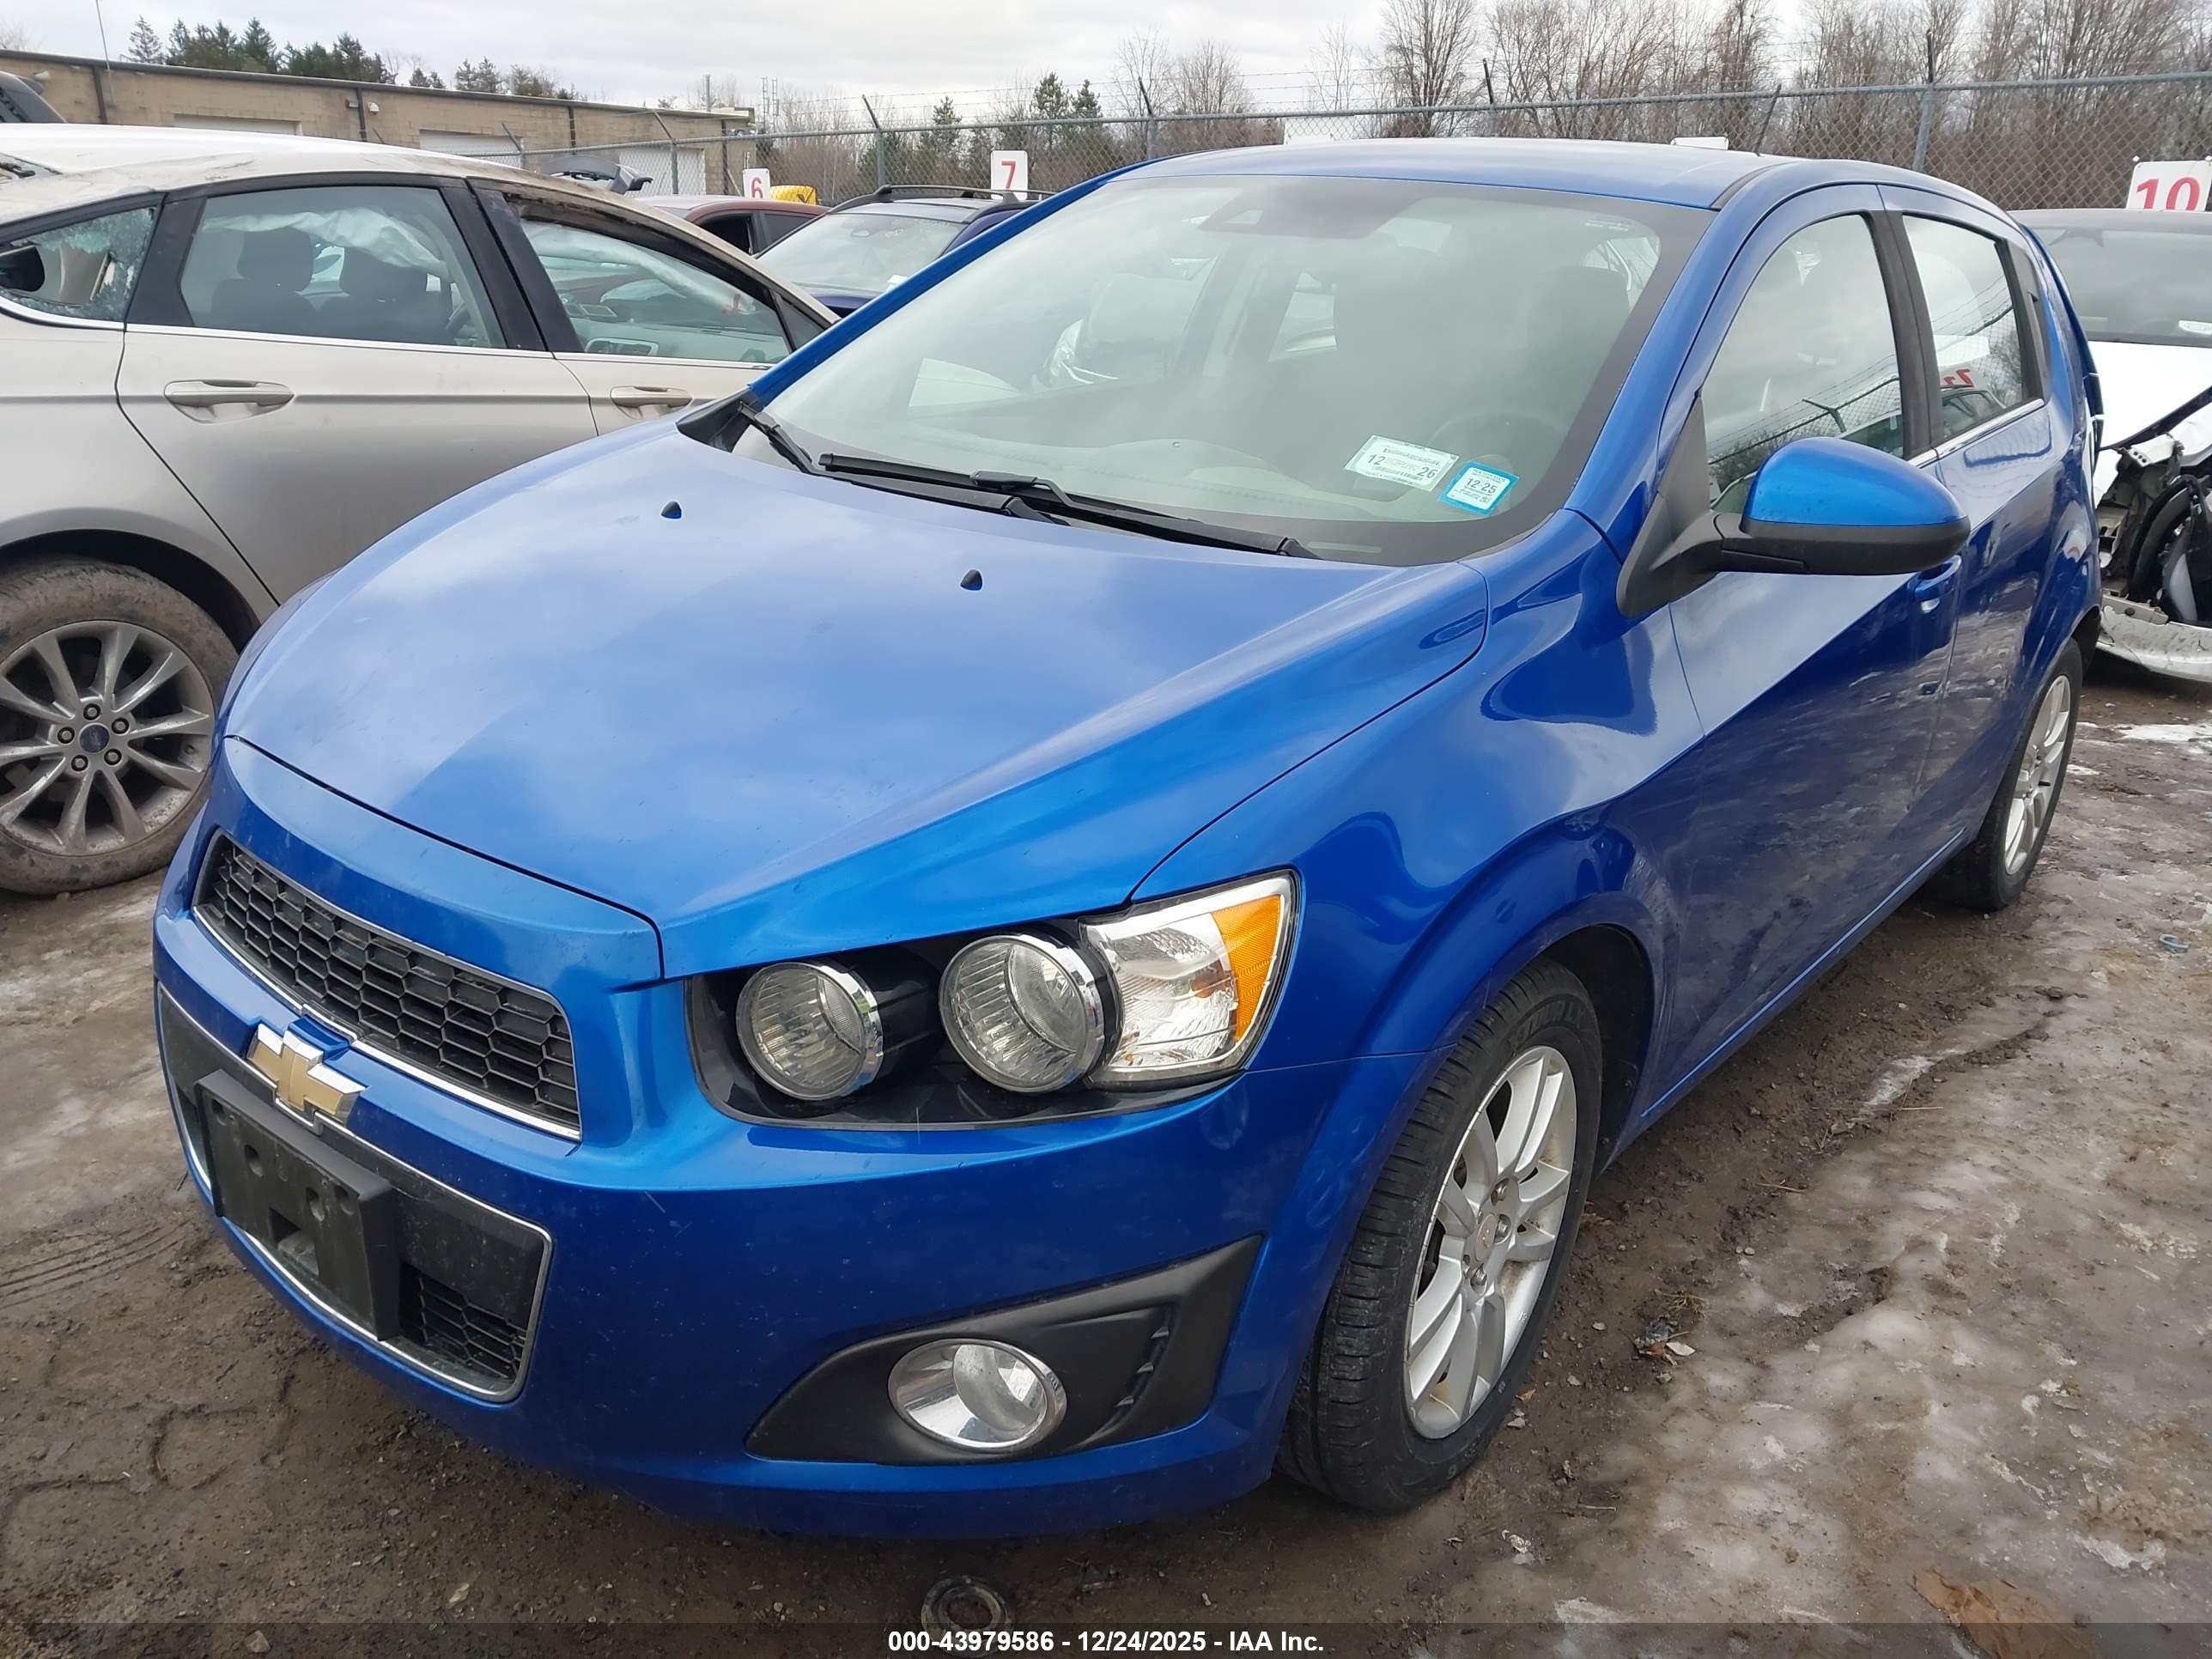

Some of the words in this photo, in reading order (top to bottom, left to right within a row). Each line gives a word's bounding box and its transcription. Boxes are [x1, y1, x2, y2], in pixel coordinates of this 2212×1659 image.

[1001, 161, 1017, 191] 7
[751, 177, 763, 198] 6
[2136, 177, 2200, 210] 10
[1367, 453, 1386, 466] 12
[1417, 465, 1438, 479] 26
